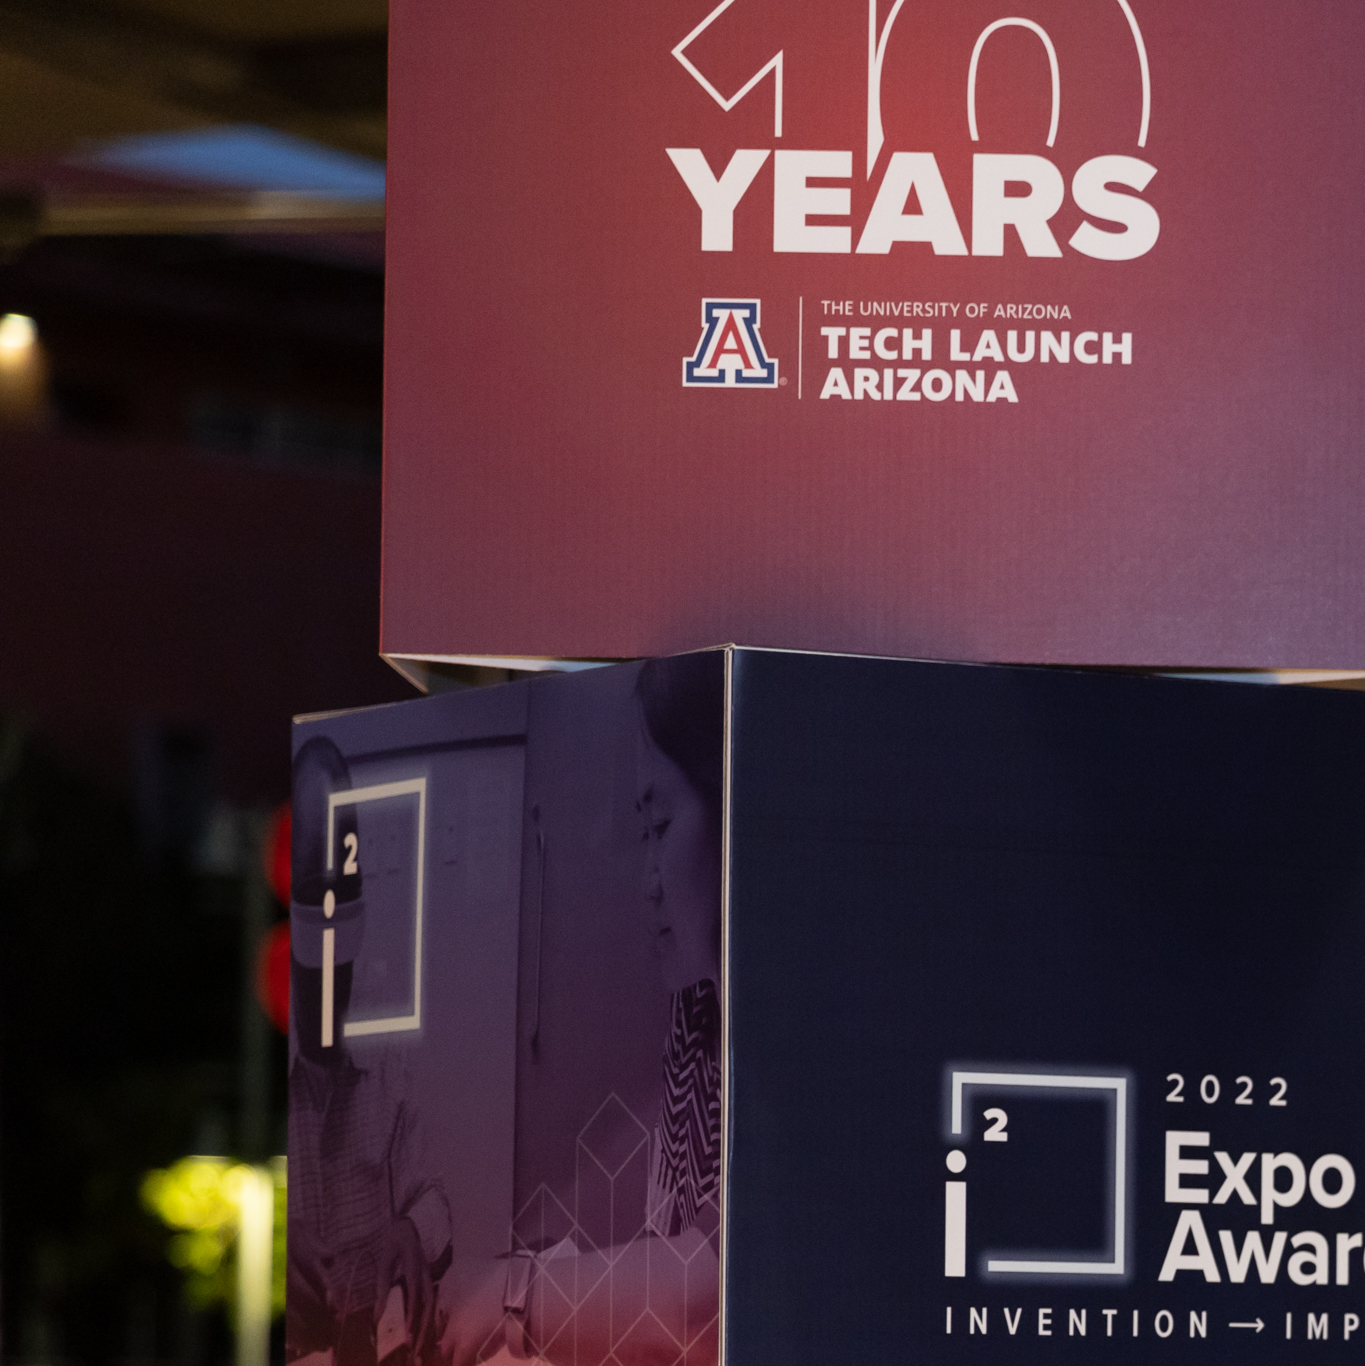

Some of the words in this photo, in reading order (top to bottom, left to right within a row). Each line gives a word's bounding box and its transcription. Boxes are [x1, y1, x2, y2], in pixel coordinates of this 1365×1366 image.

[665, 148, 1160, 260] YEARS
[821, 300, 854, 316] THE
[859, 301, 960, 318] UNIVERSITY
[965, 303, 988, 318] OF
[993, 303, 1072, 320] ARIZONA
[682, 298, 779, 388] A
[820, 326, 932, 361] TECH
[950, 329, 1133, 365] LAUNCH
[819, 367, 1019, 403] ARIZONA
[1165, 1073, 1288, 1107] 2022
[1164, 1130, 1356, 1225] Expo
[945, 1306, 1208, 1339] INVENTION
